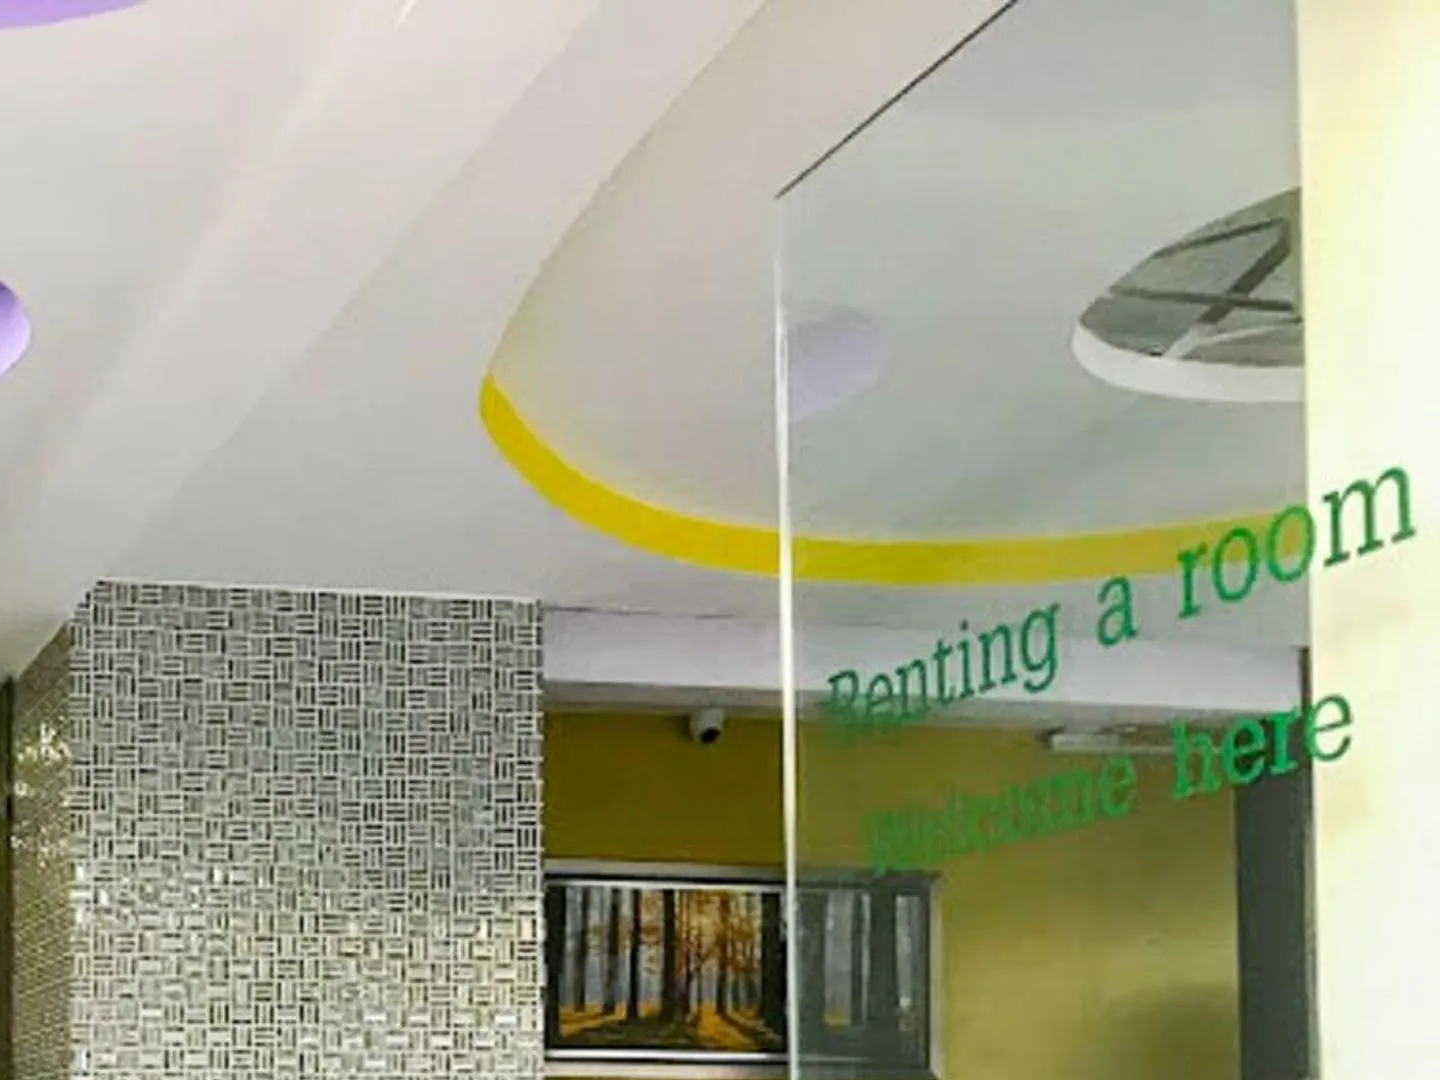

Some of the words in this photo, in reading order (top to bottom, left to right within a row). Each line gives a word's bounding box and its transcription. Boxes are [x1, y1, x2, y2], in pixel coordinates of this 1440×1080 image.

[826, 602, 1060, 742] Renting
[1097, 576, 1139, 647] a
[1176, 465, 1417, 620] room
[1171, 692, 1354, 800] here
